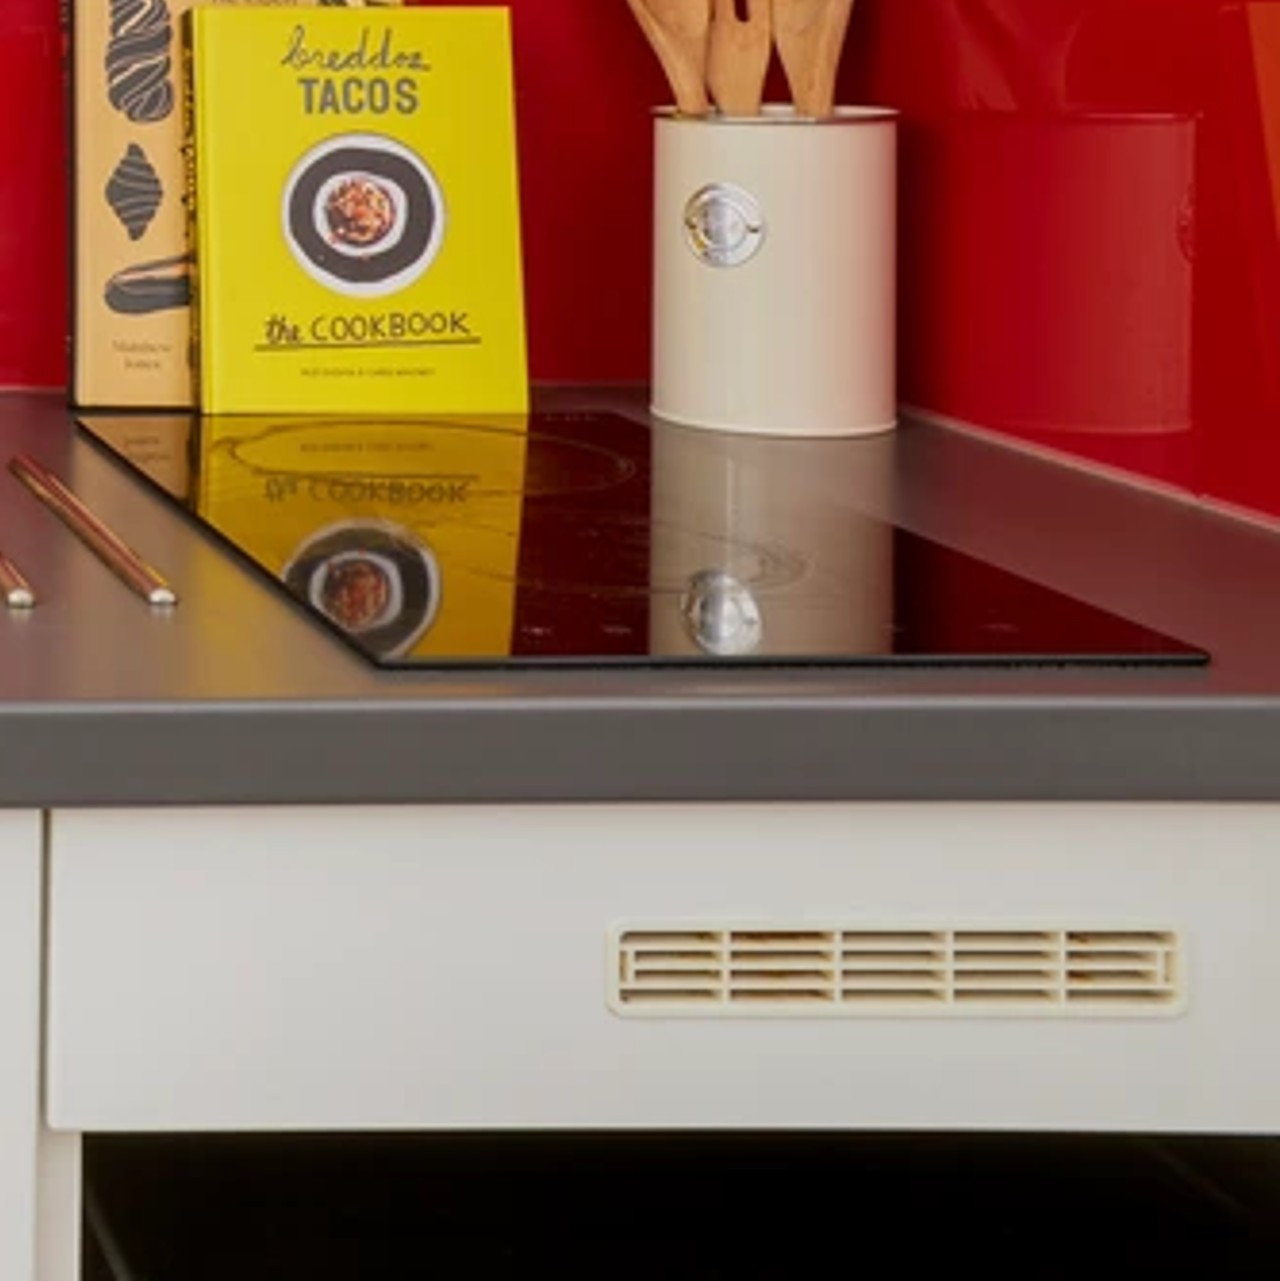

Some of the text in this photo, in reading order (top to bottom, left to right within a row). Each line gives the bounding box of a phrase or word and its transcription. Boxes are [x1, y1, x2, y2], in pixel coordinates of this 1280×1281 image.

[297, 77, 418, 115] TACOS
[265, 312, 470, 344] the COOKBOOK
